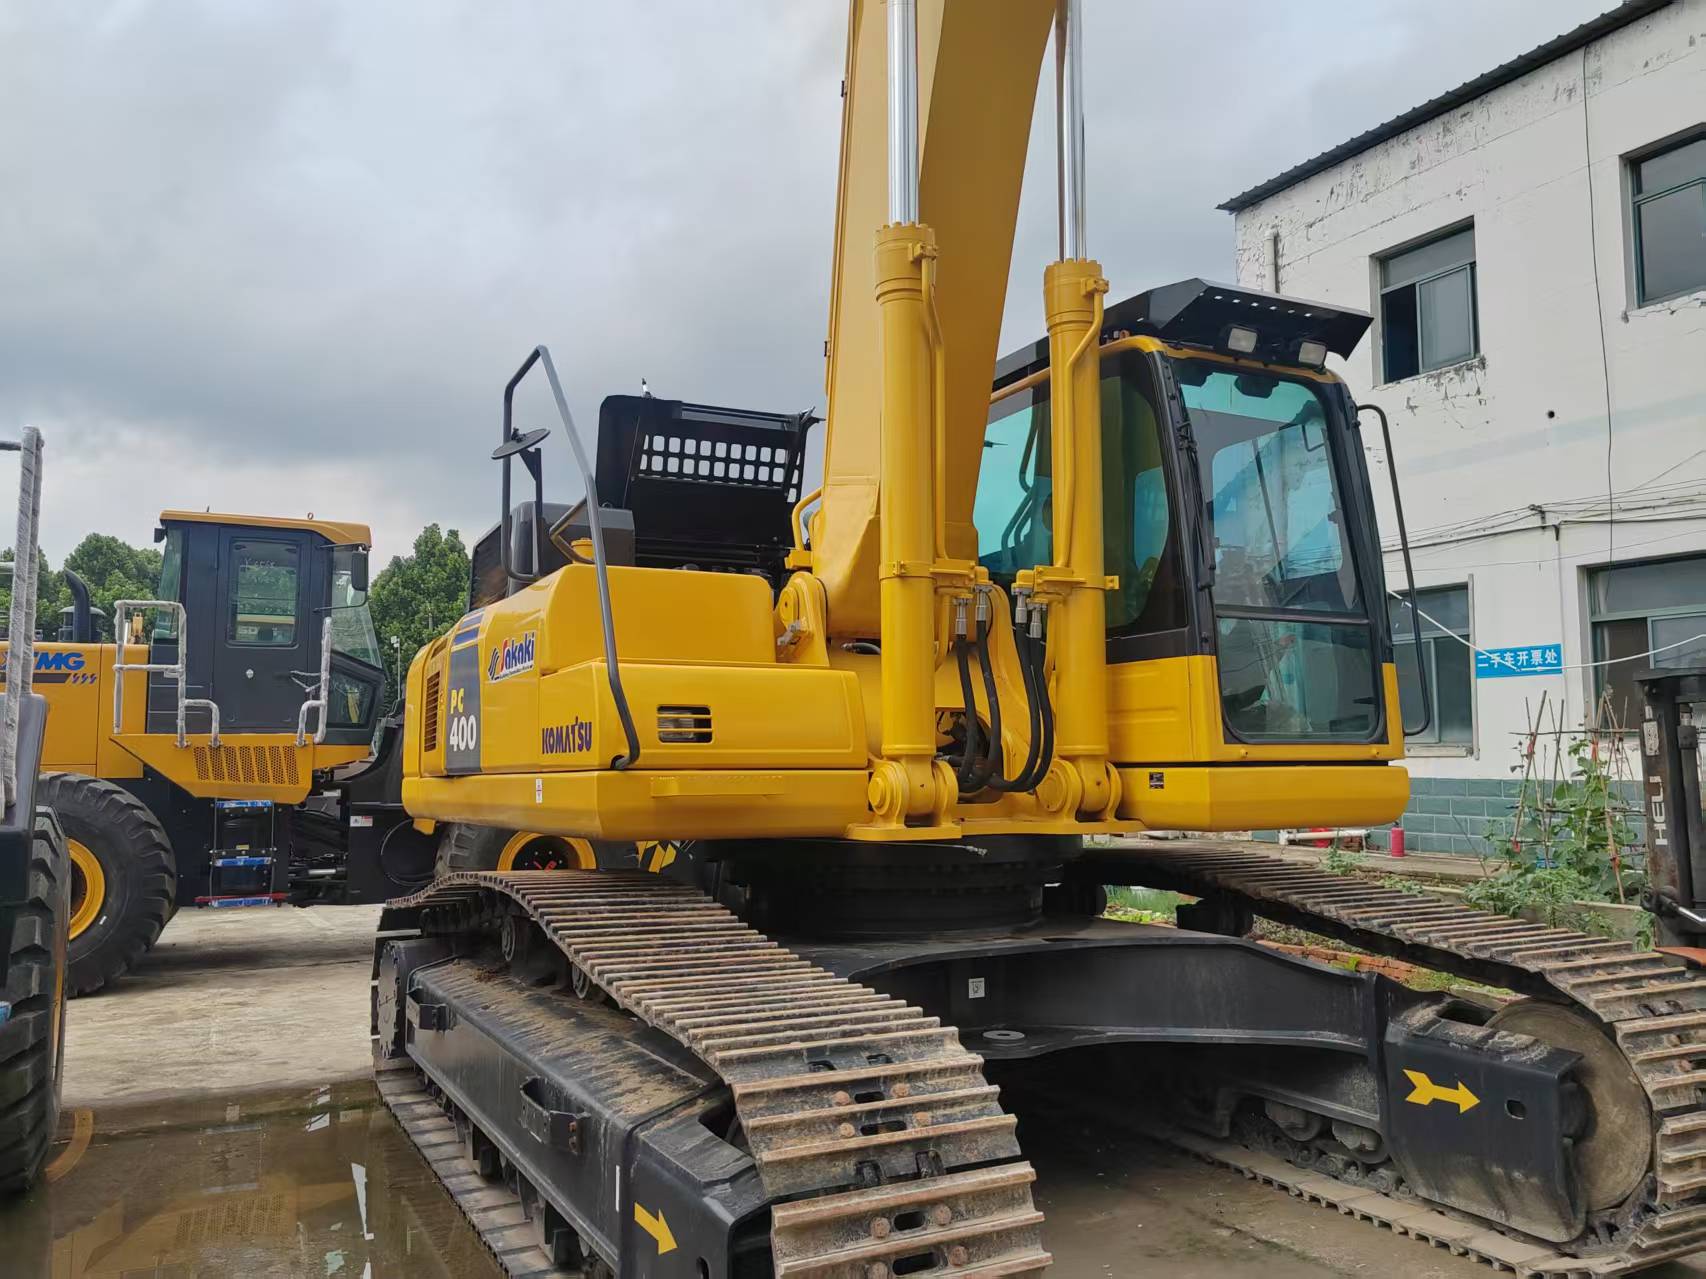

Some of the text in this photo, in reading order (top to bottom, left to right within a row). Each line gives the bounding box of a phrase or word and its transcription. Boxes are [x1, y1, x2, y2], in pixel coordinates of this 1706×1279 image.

[500, 632, 534, 673] Sakaki
[1477, 649, 1558, 669] 二手车开票处
[450, 688, 464, 714] PC
[450, 715, 477, 752] 400
[542, 716, 592, 754] KOMATSU
[1649, 775, 1668, 845] HELI
